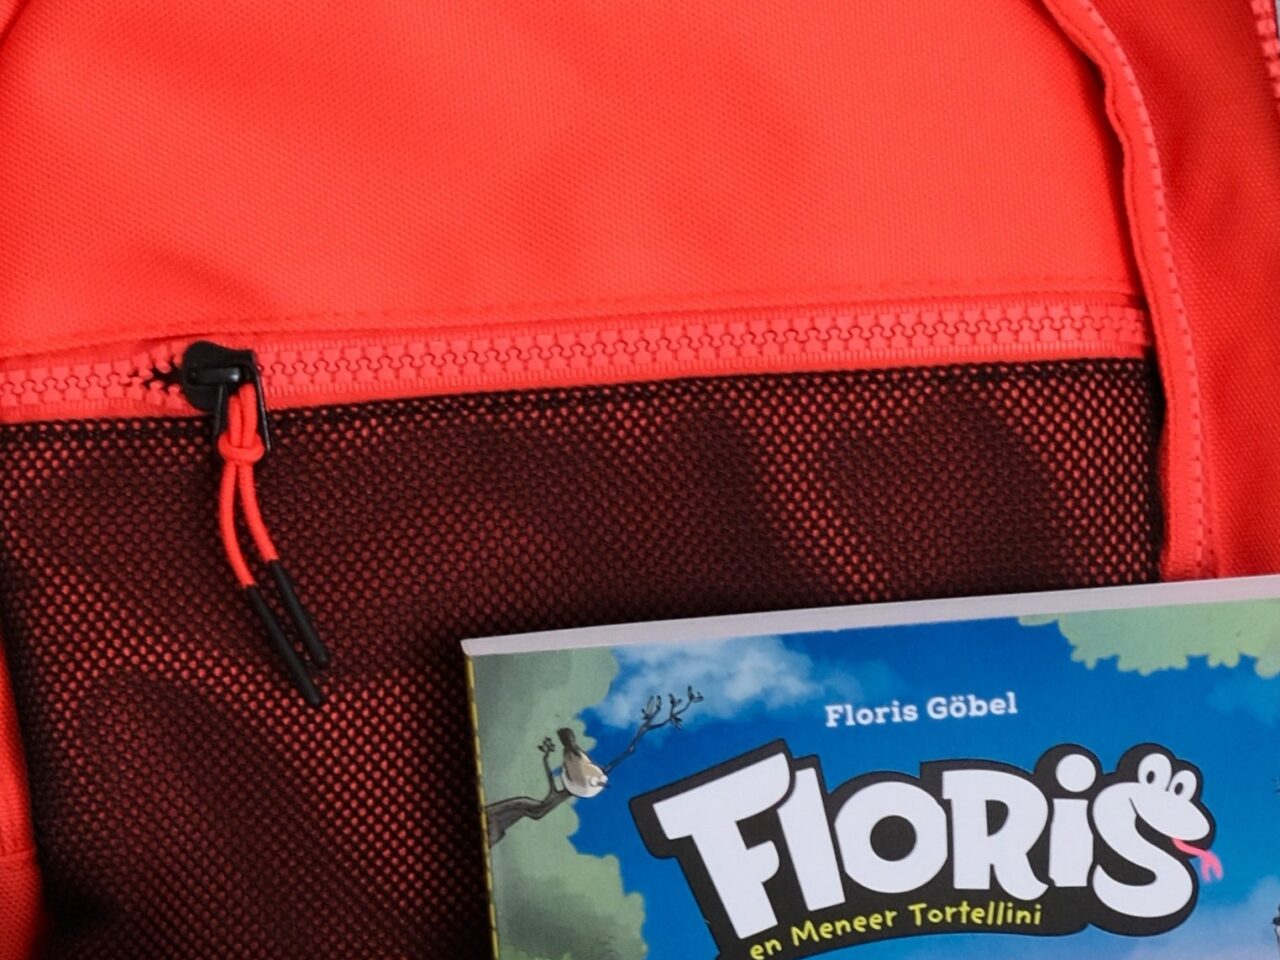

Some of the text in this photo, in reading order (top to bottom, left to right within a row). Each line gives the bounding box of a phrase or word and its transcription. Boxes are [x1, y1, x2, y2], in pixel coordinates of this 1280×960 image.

[825, 692, 1018, 728] Floris Göbel
[749, 901, 1042, 960] en Meneer Tortellini
